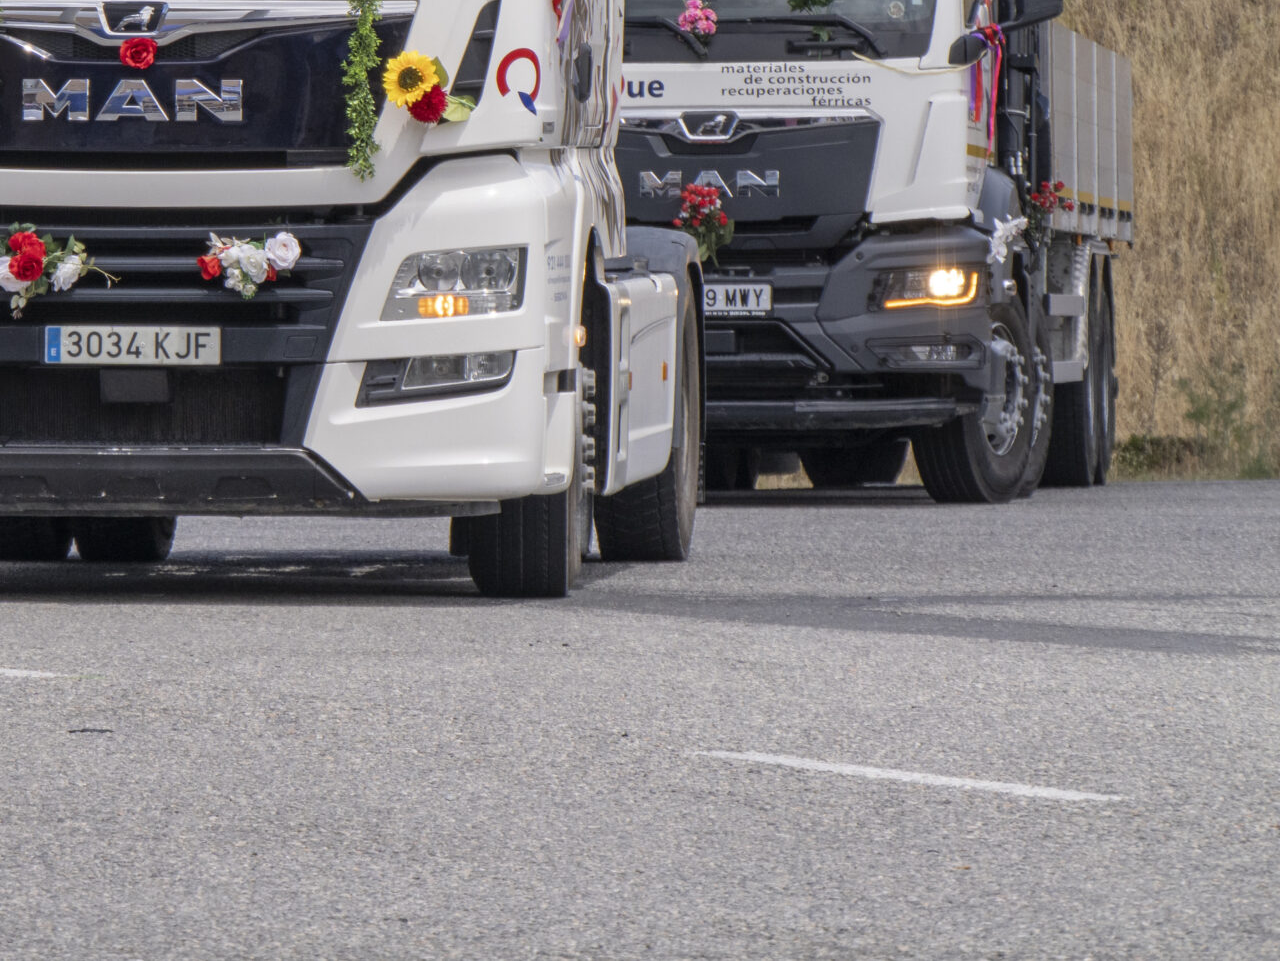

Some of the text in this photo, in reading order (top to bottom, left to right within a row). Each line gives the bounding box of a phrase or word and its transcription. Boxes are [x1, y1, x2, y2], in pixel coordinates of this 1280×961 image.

[721, 62, 805, 74] materiales
[743, 73, 871, 85] de construcción
[721, 85, 843, 97] recuperaciones
[22, 78, 243, 121] MAN
[811, 96, 871, 107] férricas
[639, 170, 779, 198] MAN
[725, 288, 764, 308] MWY
[67, 331, 211, 360] 3034 KJF
